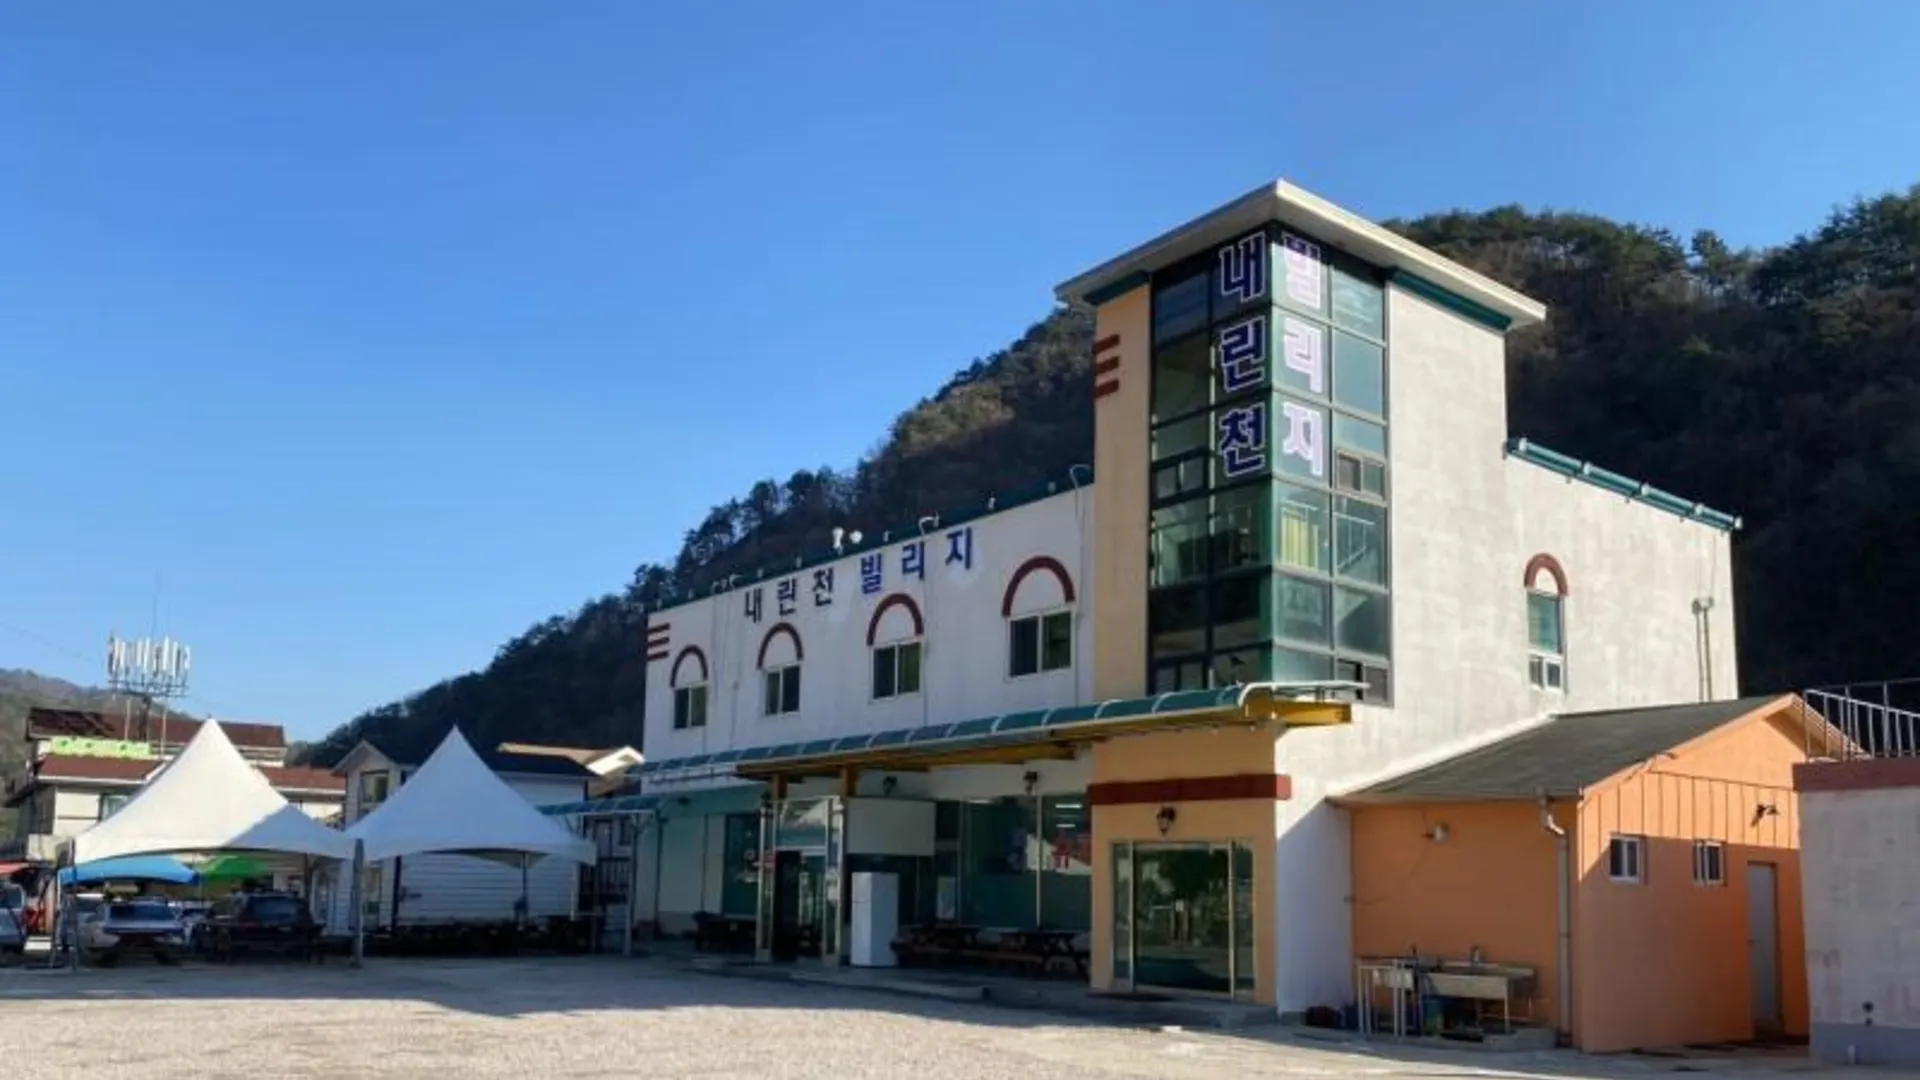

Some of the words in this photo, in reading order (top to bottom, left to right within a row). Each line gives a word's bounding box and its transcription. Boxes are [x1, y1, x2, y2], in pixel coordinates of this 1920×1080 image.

[1218, 231, 1266, 477] 내린천
[1281, 231, 1324, 477] 빌리지
[860, 526, 972, 595] 빌리지
